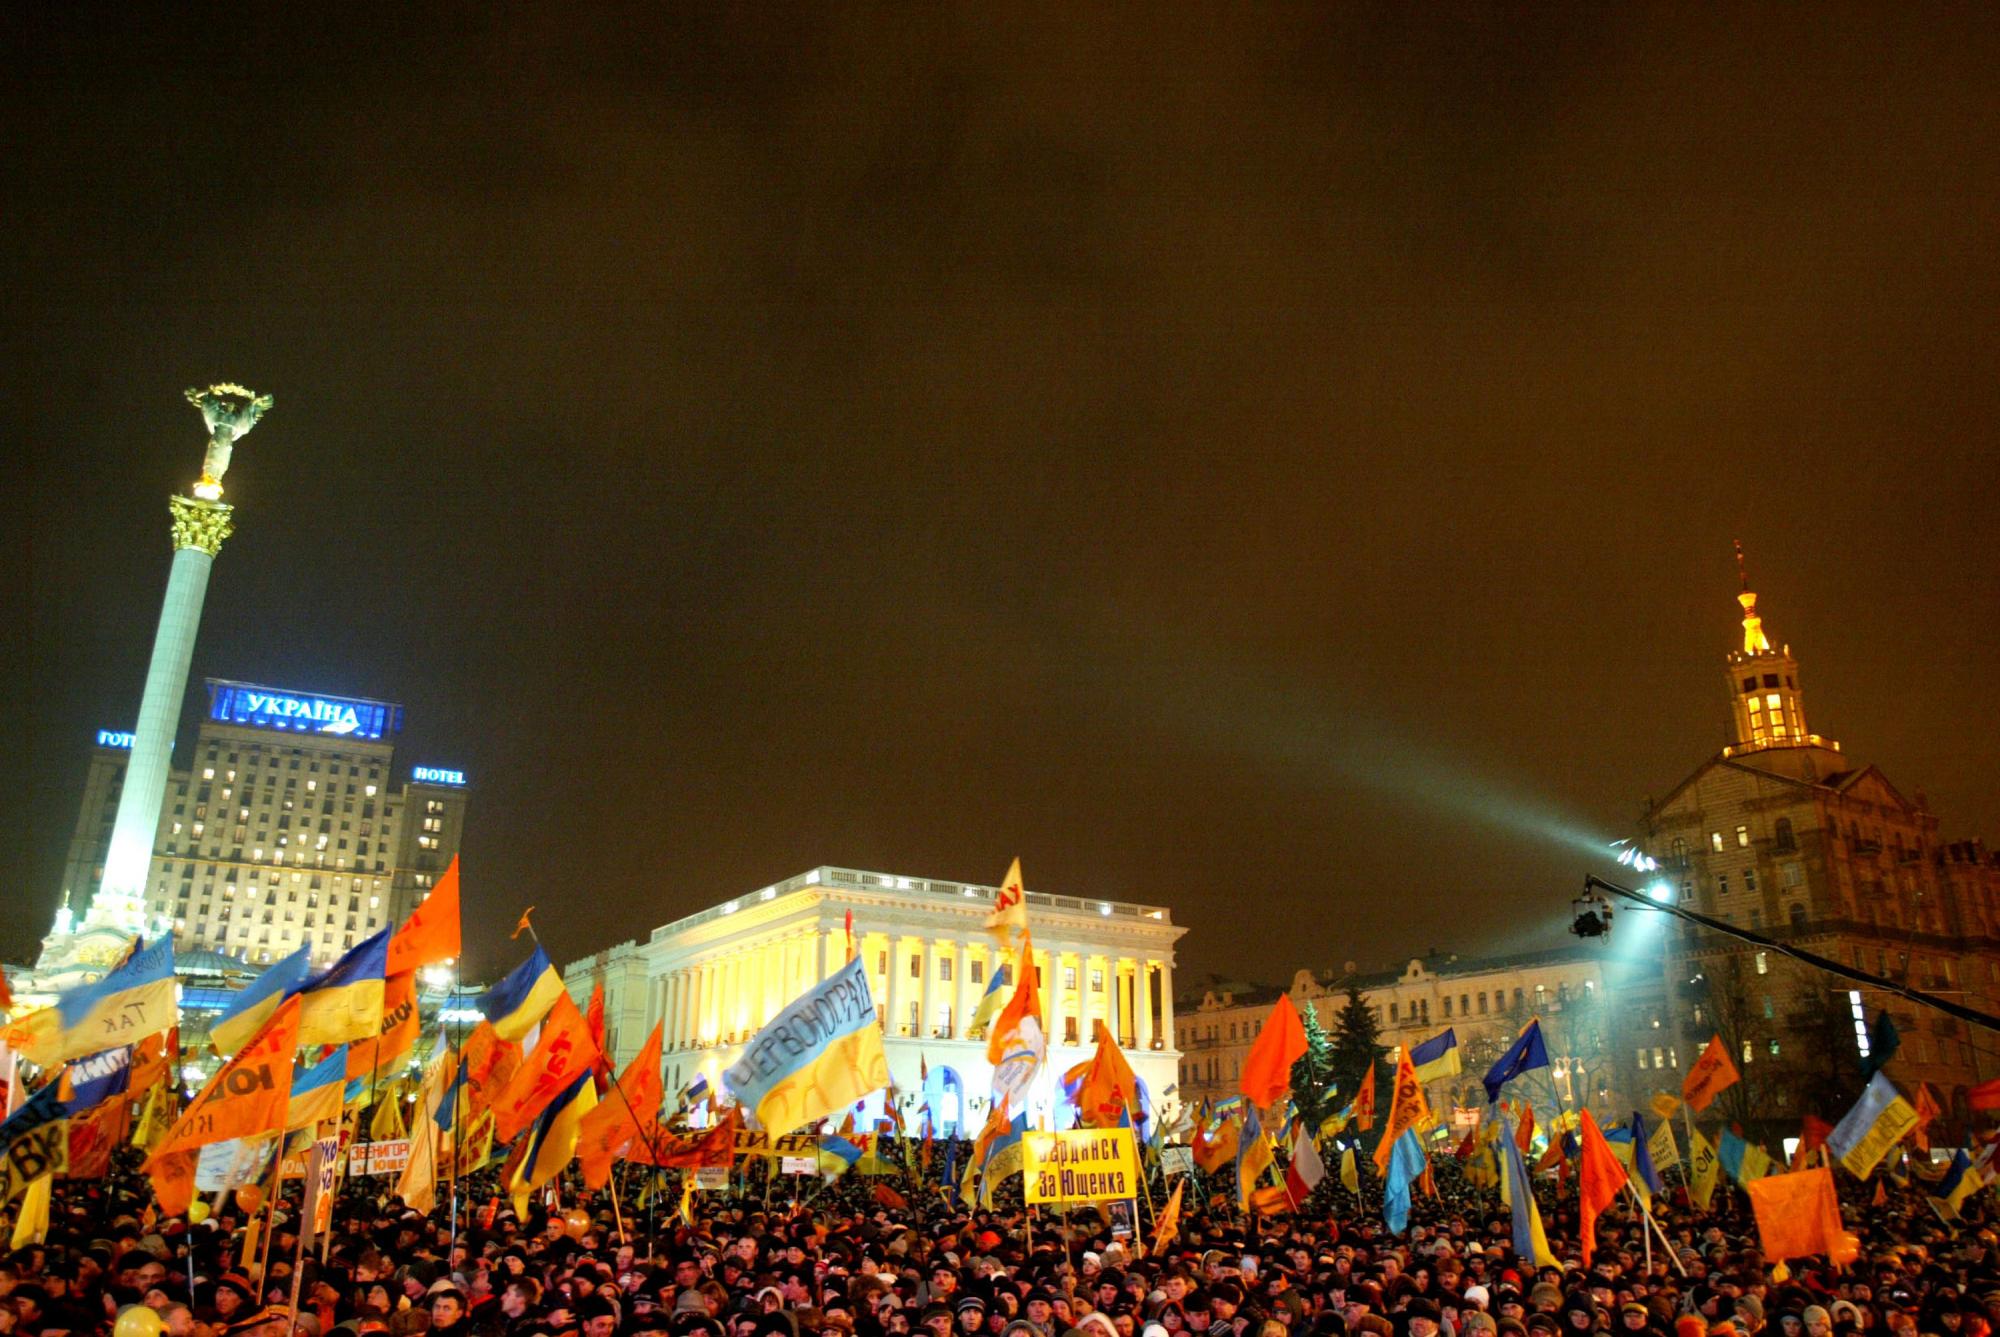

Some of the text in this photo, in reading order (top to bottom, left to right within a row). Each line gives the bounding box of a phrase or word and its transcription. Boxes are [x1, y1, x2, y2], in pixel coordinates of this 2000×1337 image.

[248, 694, 359, 729] УКРАЇНА
[414, 766, 466, 784] HOTEL
[730, 968, 873, 1086] ЧЕРВОНОГРАД
[352, 1143, 410, 1161] ЗВЕНИГОР
[373, 1158, 409, 1171] ЮЩЕ
[1040, 1168, 1125, 1198] За Ющенка
